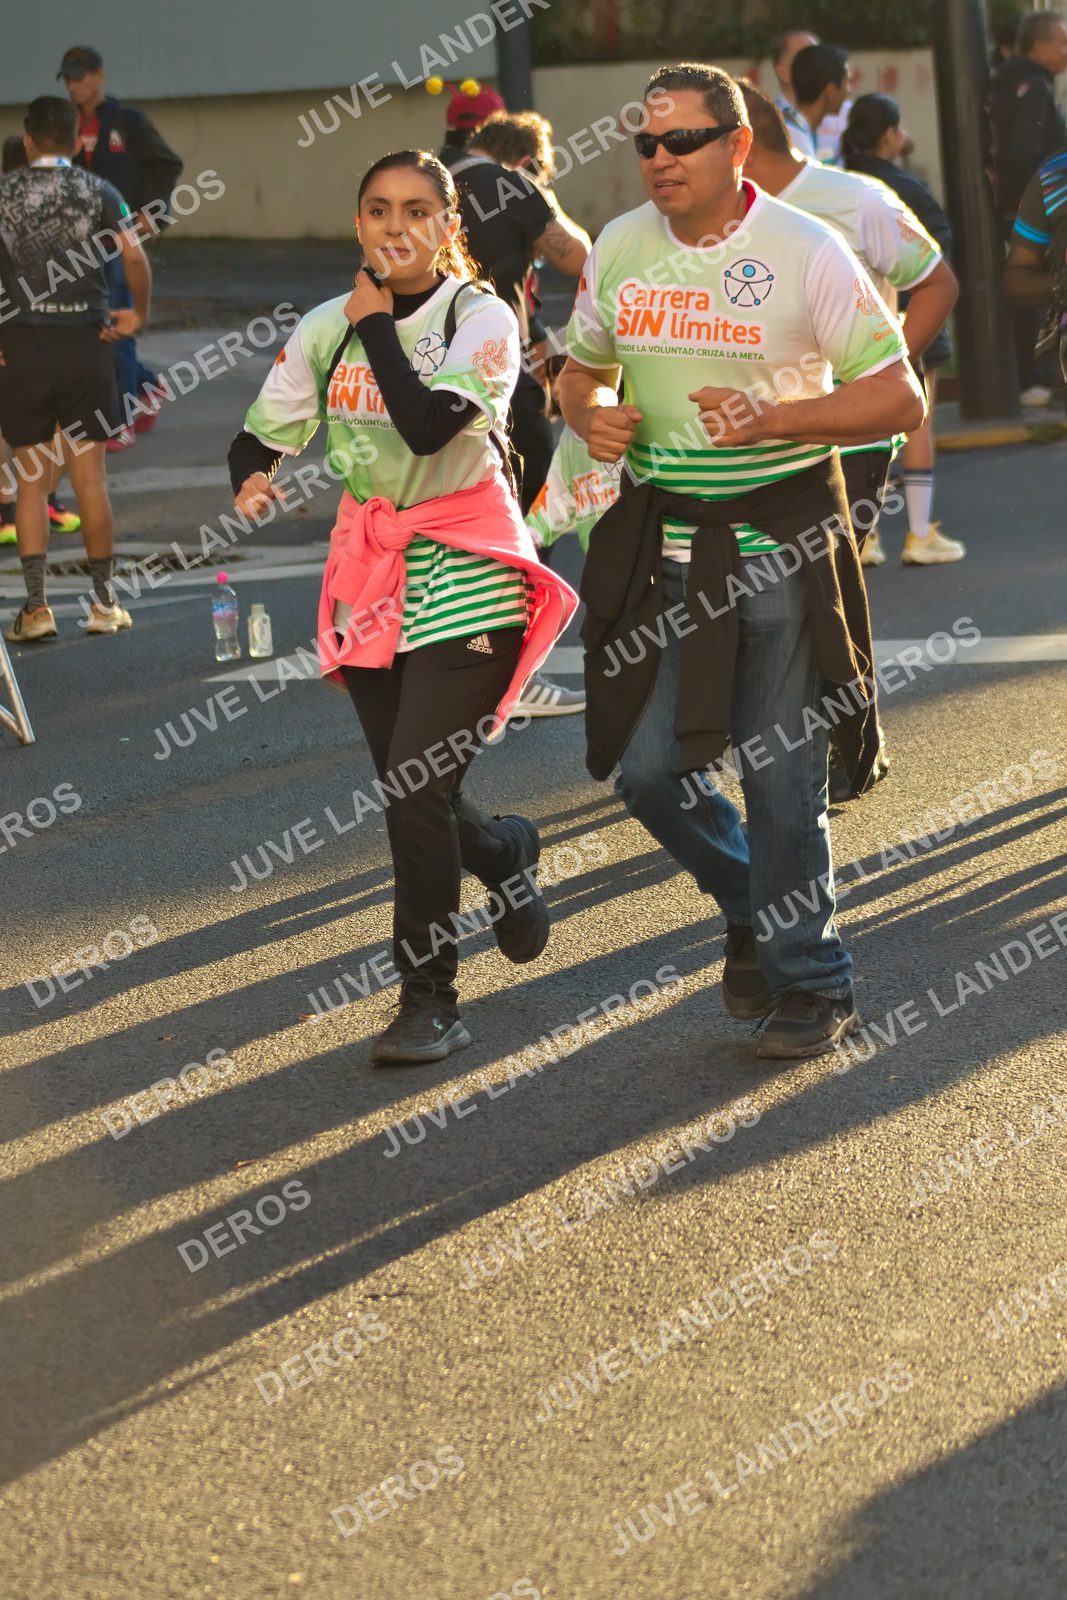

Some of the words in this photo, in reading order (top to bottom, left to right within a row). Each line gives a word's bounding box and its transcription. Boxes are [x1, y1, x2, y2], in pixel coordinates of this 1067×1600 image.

[619, 283, 709, 311] Carrera
[617, 309, 666, 337] SIN
[670, 312, 761, 345] límites
[637, 345, 647, 353] LA
[648, 345, 695, 356] VOLUNTAD
[696, 348, 724, 358] CRUZA
[727, 350, 737, 359] LA
[739, 352, 764, 361] META
[327, 383, 361, 412] IN
[466, 642, 493, 655] adidas
